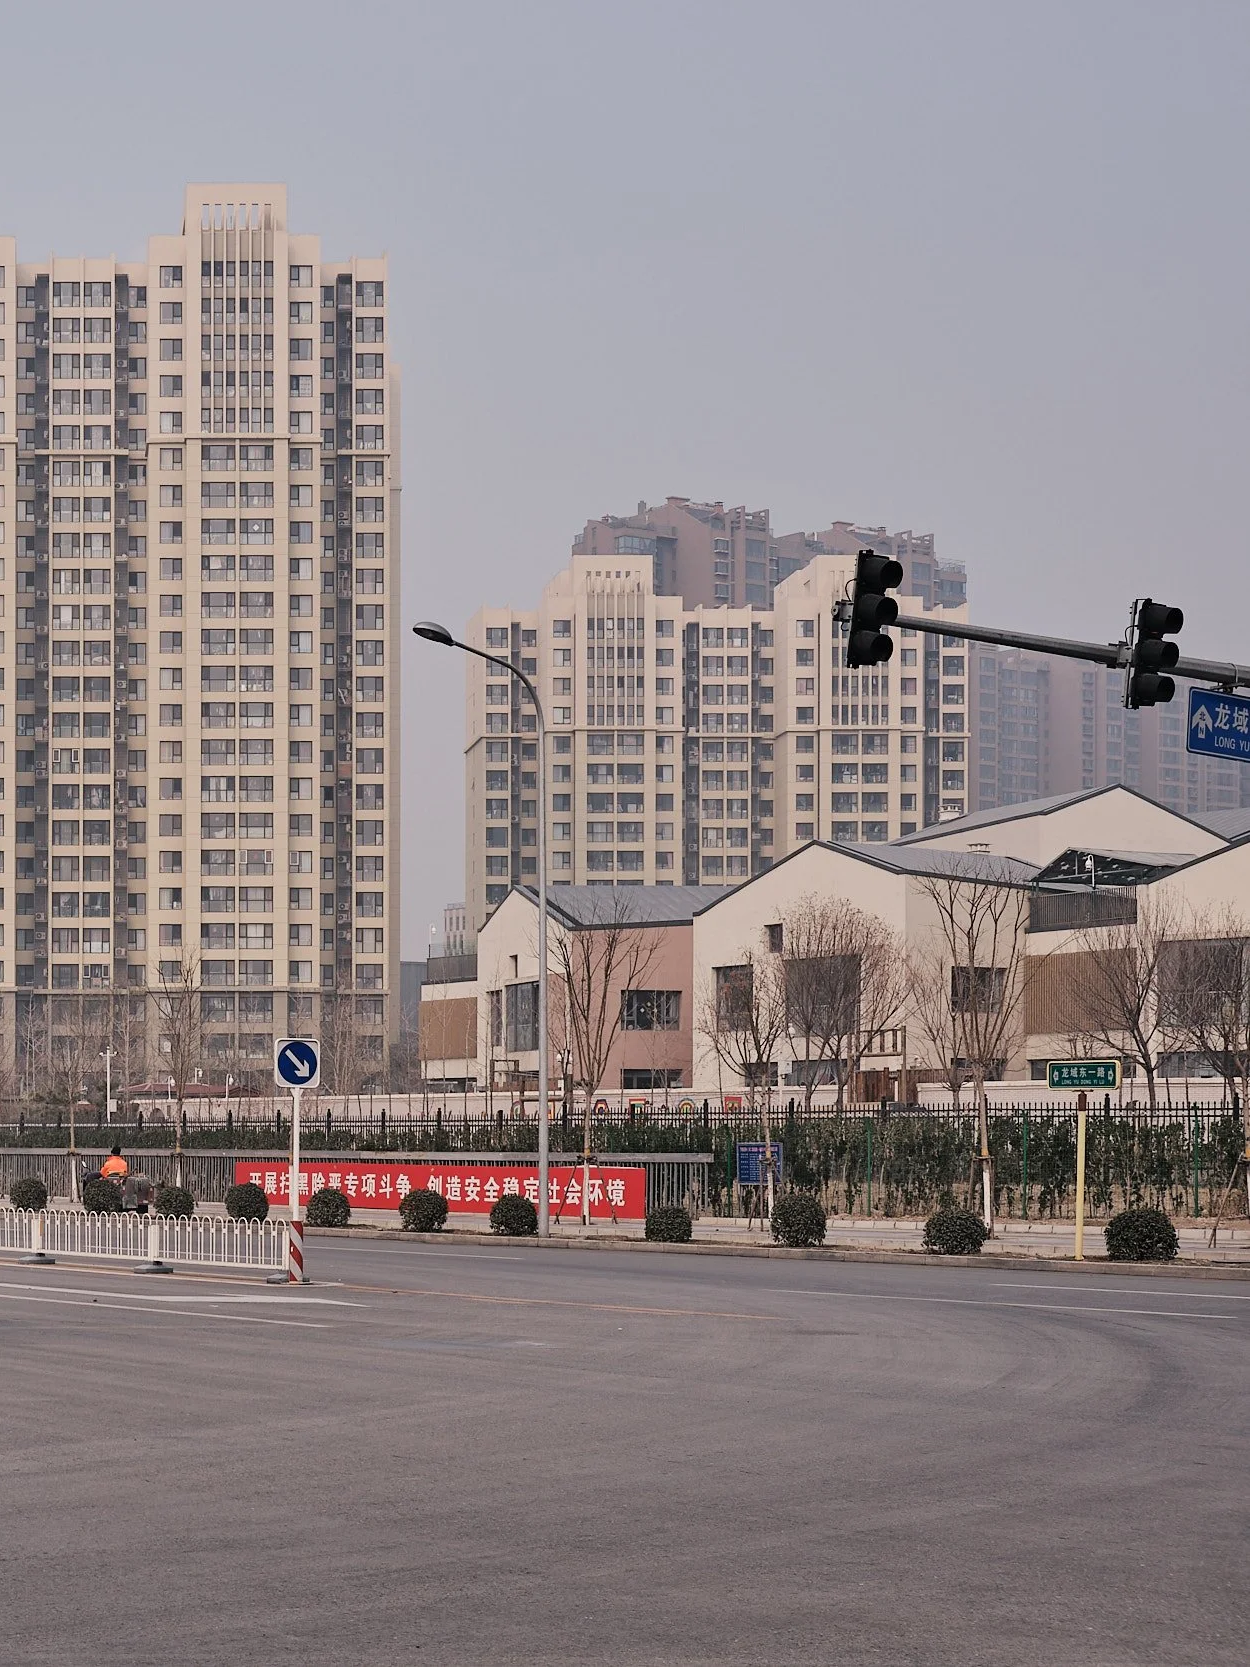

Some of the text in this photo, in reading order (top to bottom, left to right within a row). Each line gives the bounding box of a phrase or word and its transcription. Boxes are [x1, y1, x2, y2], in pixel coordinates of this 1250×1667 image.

[1214, 702, 1249, 734] 龙域
[1214, 736, 1236, 749] LONG
[1061, 1067, 1105, 1078] 龙域东一路
